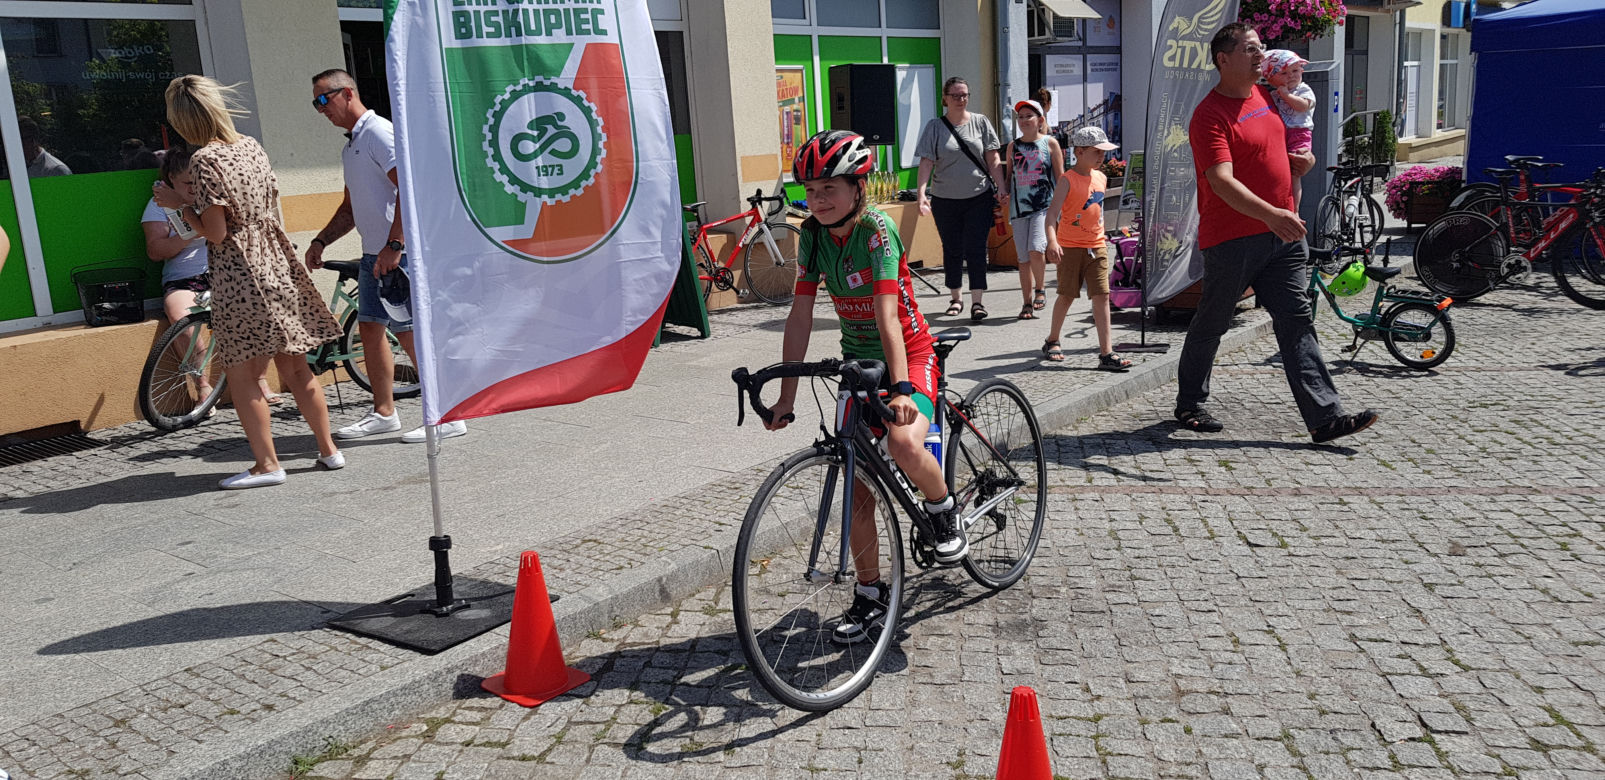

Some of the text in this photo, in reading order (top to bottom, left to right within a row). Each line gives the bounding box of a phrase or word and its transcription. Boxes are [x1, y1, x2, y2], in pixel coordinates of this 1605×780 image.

[452, 8, 608, 40] BISKUPIEC
[82, 69, 125, 82] uwolnij
[535, 163, 563, 177] 1973
[1446, 217, 1470, 227] PRO
